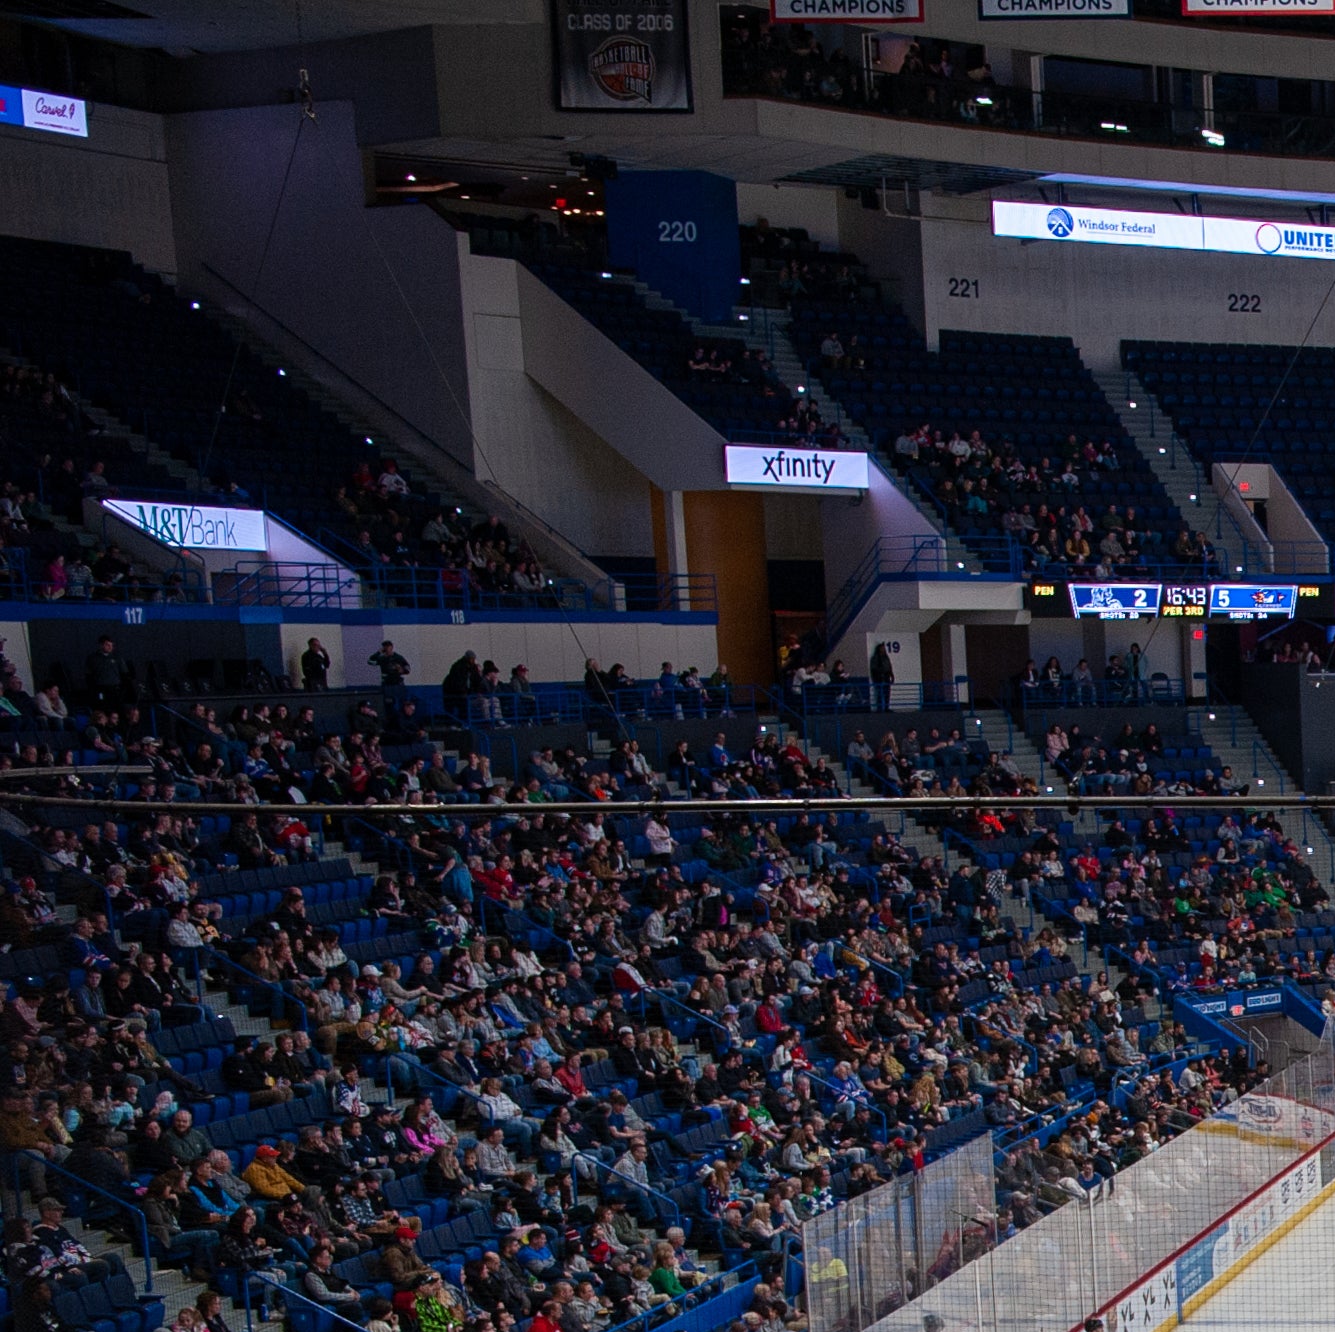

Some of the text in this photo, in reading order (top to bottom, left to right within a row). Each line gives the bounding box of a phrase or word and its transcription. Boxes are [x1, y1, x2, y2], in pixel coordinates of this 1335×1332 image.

[568, 14, 611, 30] CLASS
[616, 14, 632, 30] OF
[658, 221, 697, 242] 220
[1078, 219, 1156, 235] Windsor Federal
[948, 278, 980, 300] 221
[1228, 294, 1262, 313] 222
[762, 451, 835, 484] xfinity
[190, 508, 238, 546] Bank
[1035, 586, 1054, 596] PEN
[1134, 589, 1148, 607] 2
[1167, 587, 1206, 605] 16:43
[1218, 589, 1230, 607] 5
[124, 607, 143, 624] 117
[1163, 606, 1204, 616] PER 3RD
